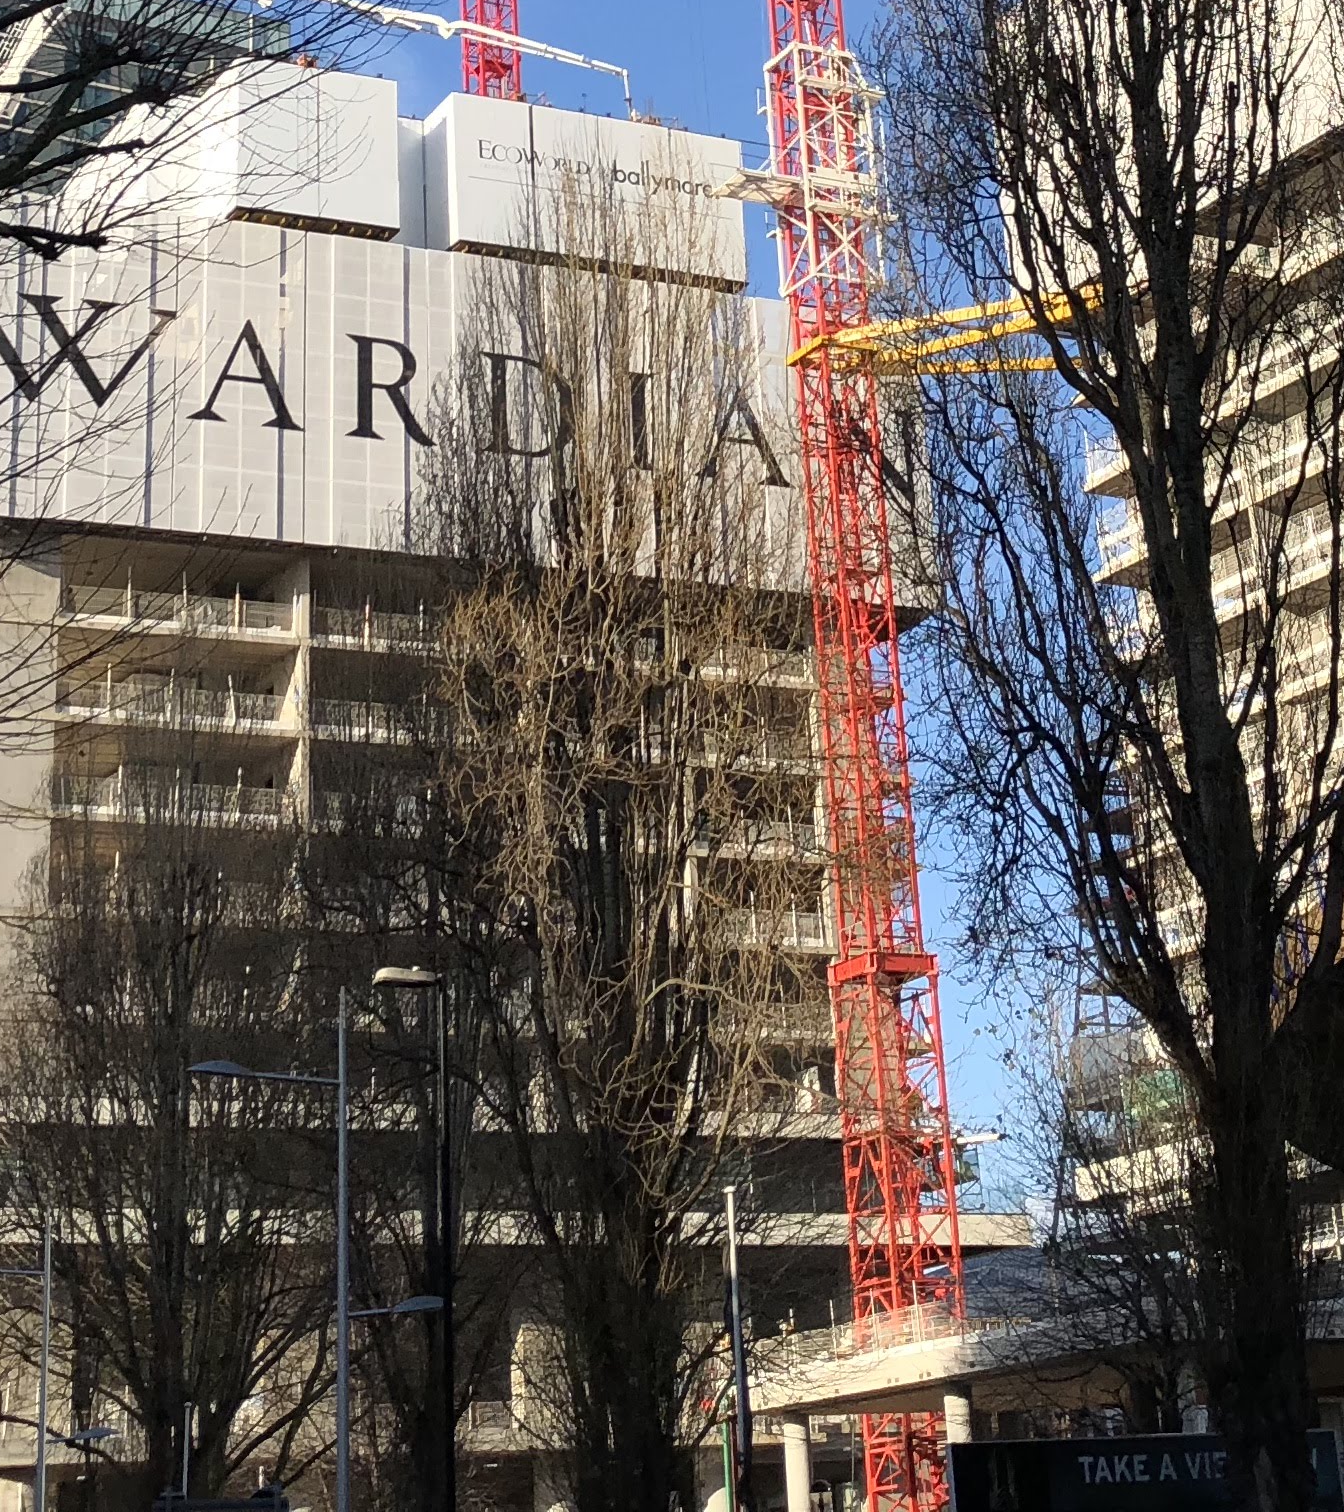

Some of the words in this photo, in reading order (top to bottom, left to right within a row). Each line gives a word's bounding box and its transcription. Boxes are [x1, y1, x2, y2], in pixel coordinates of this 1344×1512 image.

[1078, 1455, 1150, 1484] TAKE
[1159, 1453, 1178, 1481] A
[1184, 1451, 1227, 1480] VIE
